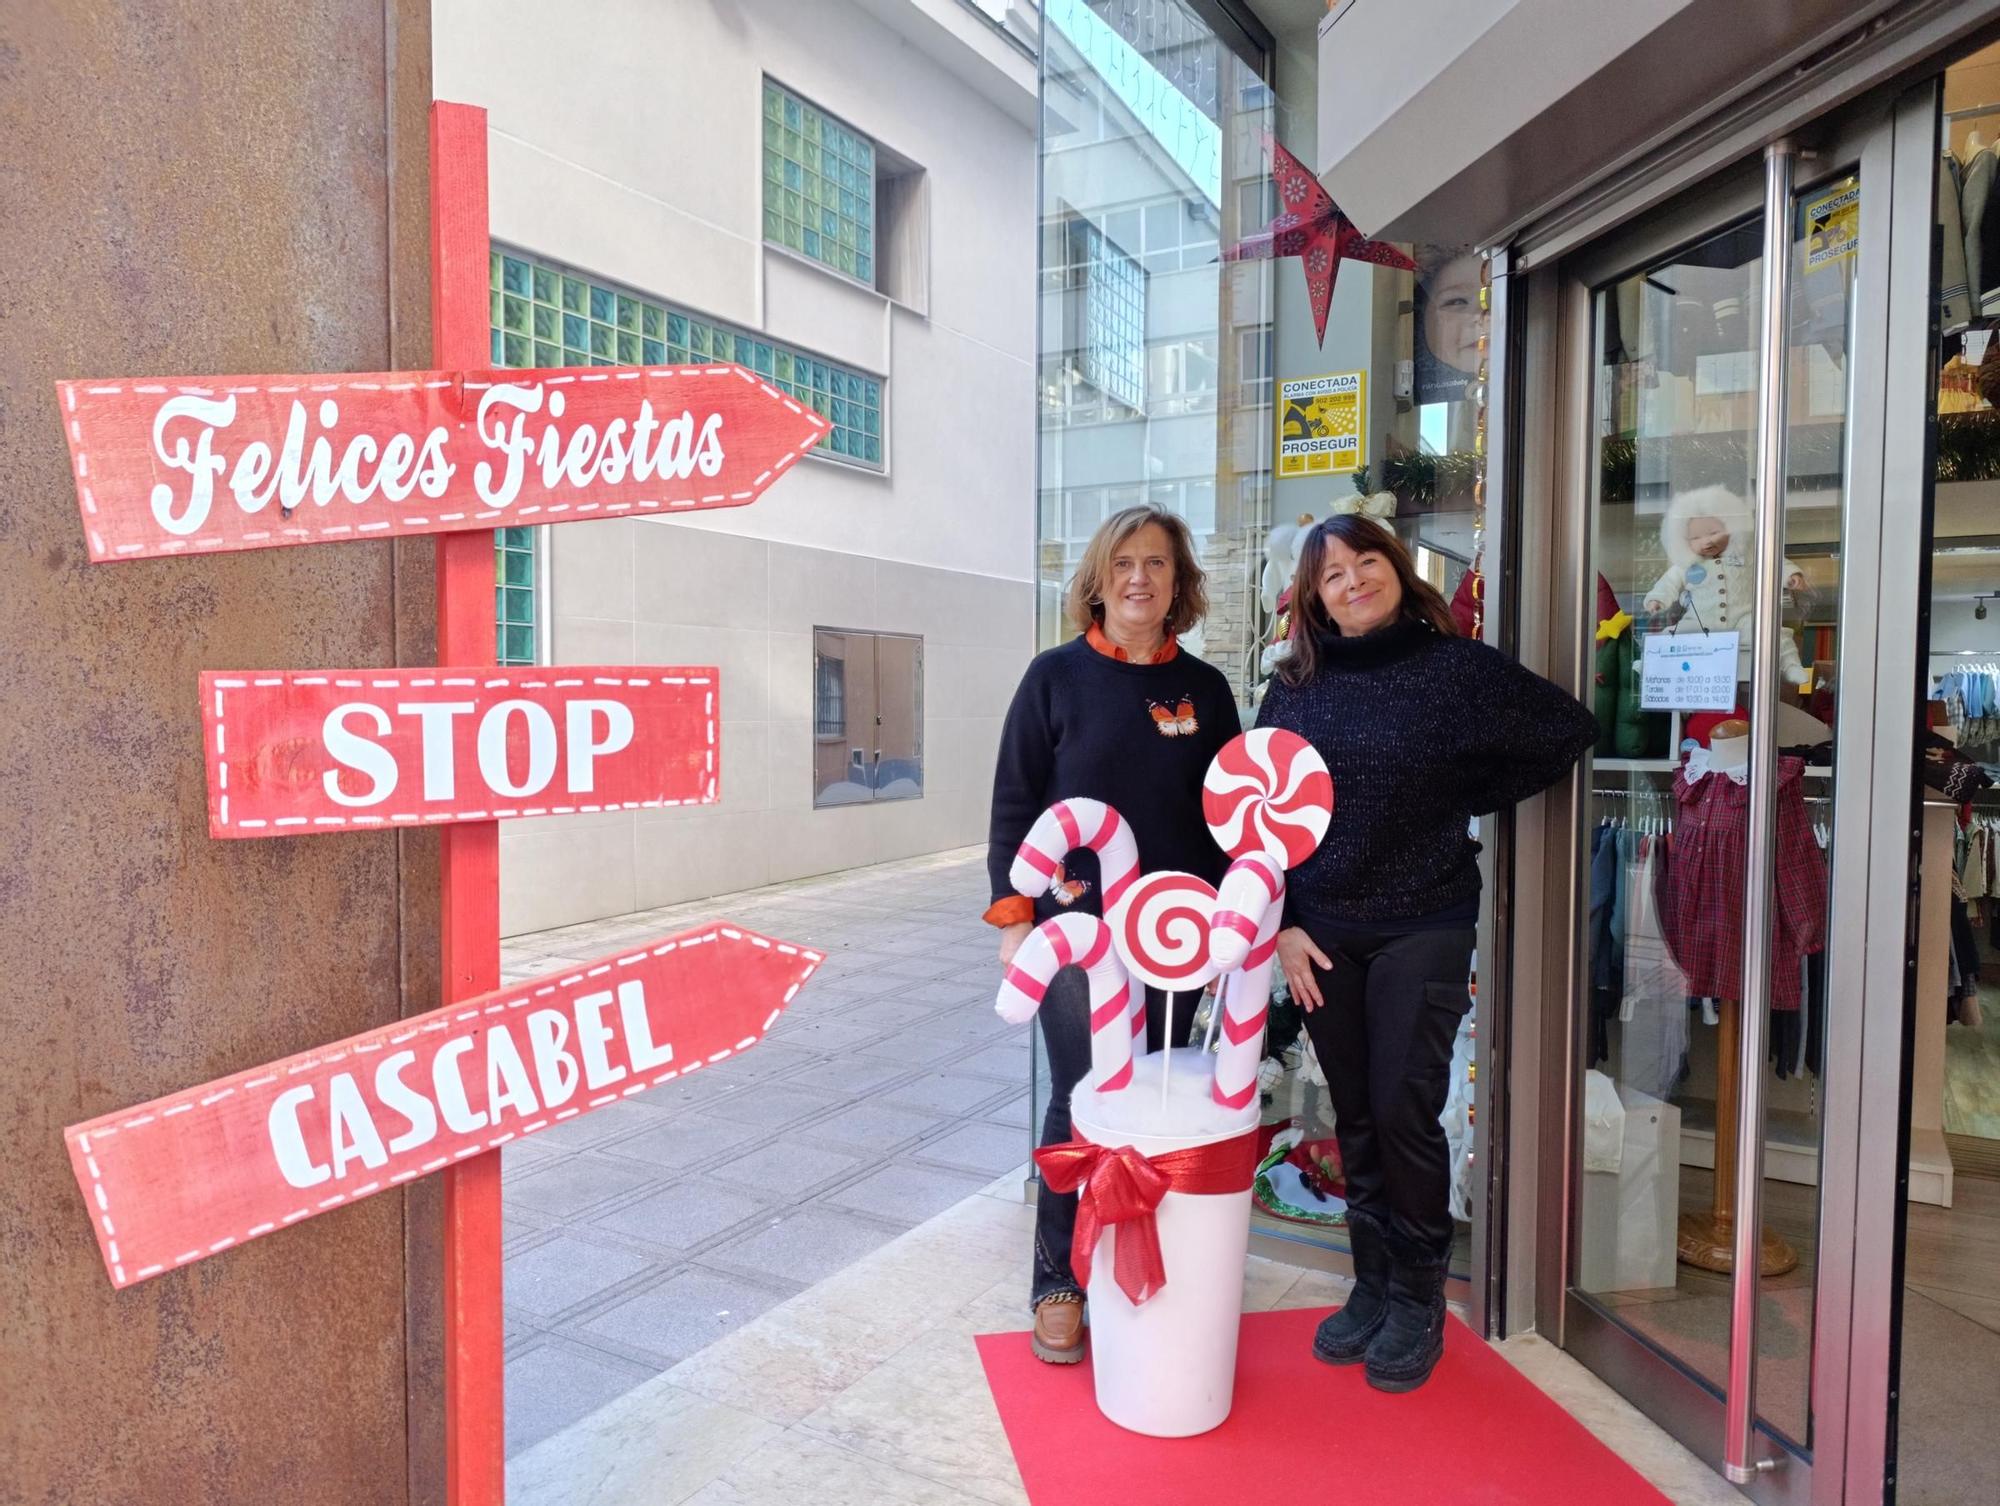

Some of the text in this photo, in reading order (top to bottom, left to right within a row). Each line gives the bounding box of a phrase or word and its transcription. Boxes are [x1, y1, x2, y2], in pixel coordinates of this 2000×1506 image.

[1283, 376, 1358, 393] CONECTADA
[150, 382, 726, 535] Felices Fiestas
[1282, 437, 1357, 454] PROSEGUR
[323, 699, 635, 808] STOP
[268, 980, 674, 1189] CASCABEL
